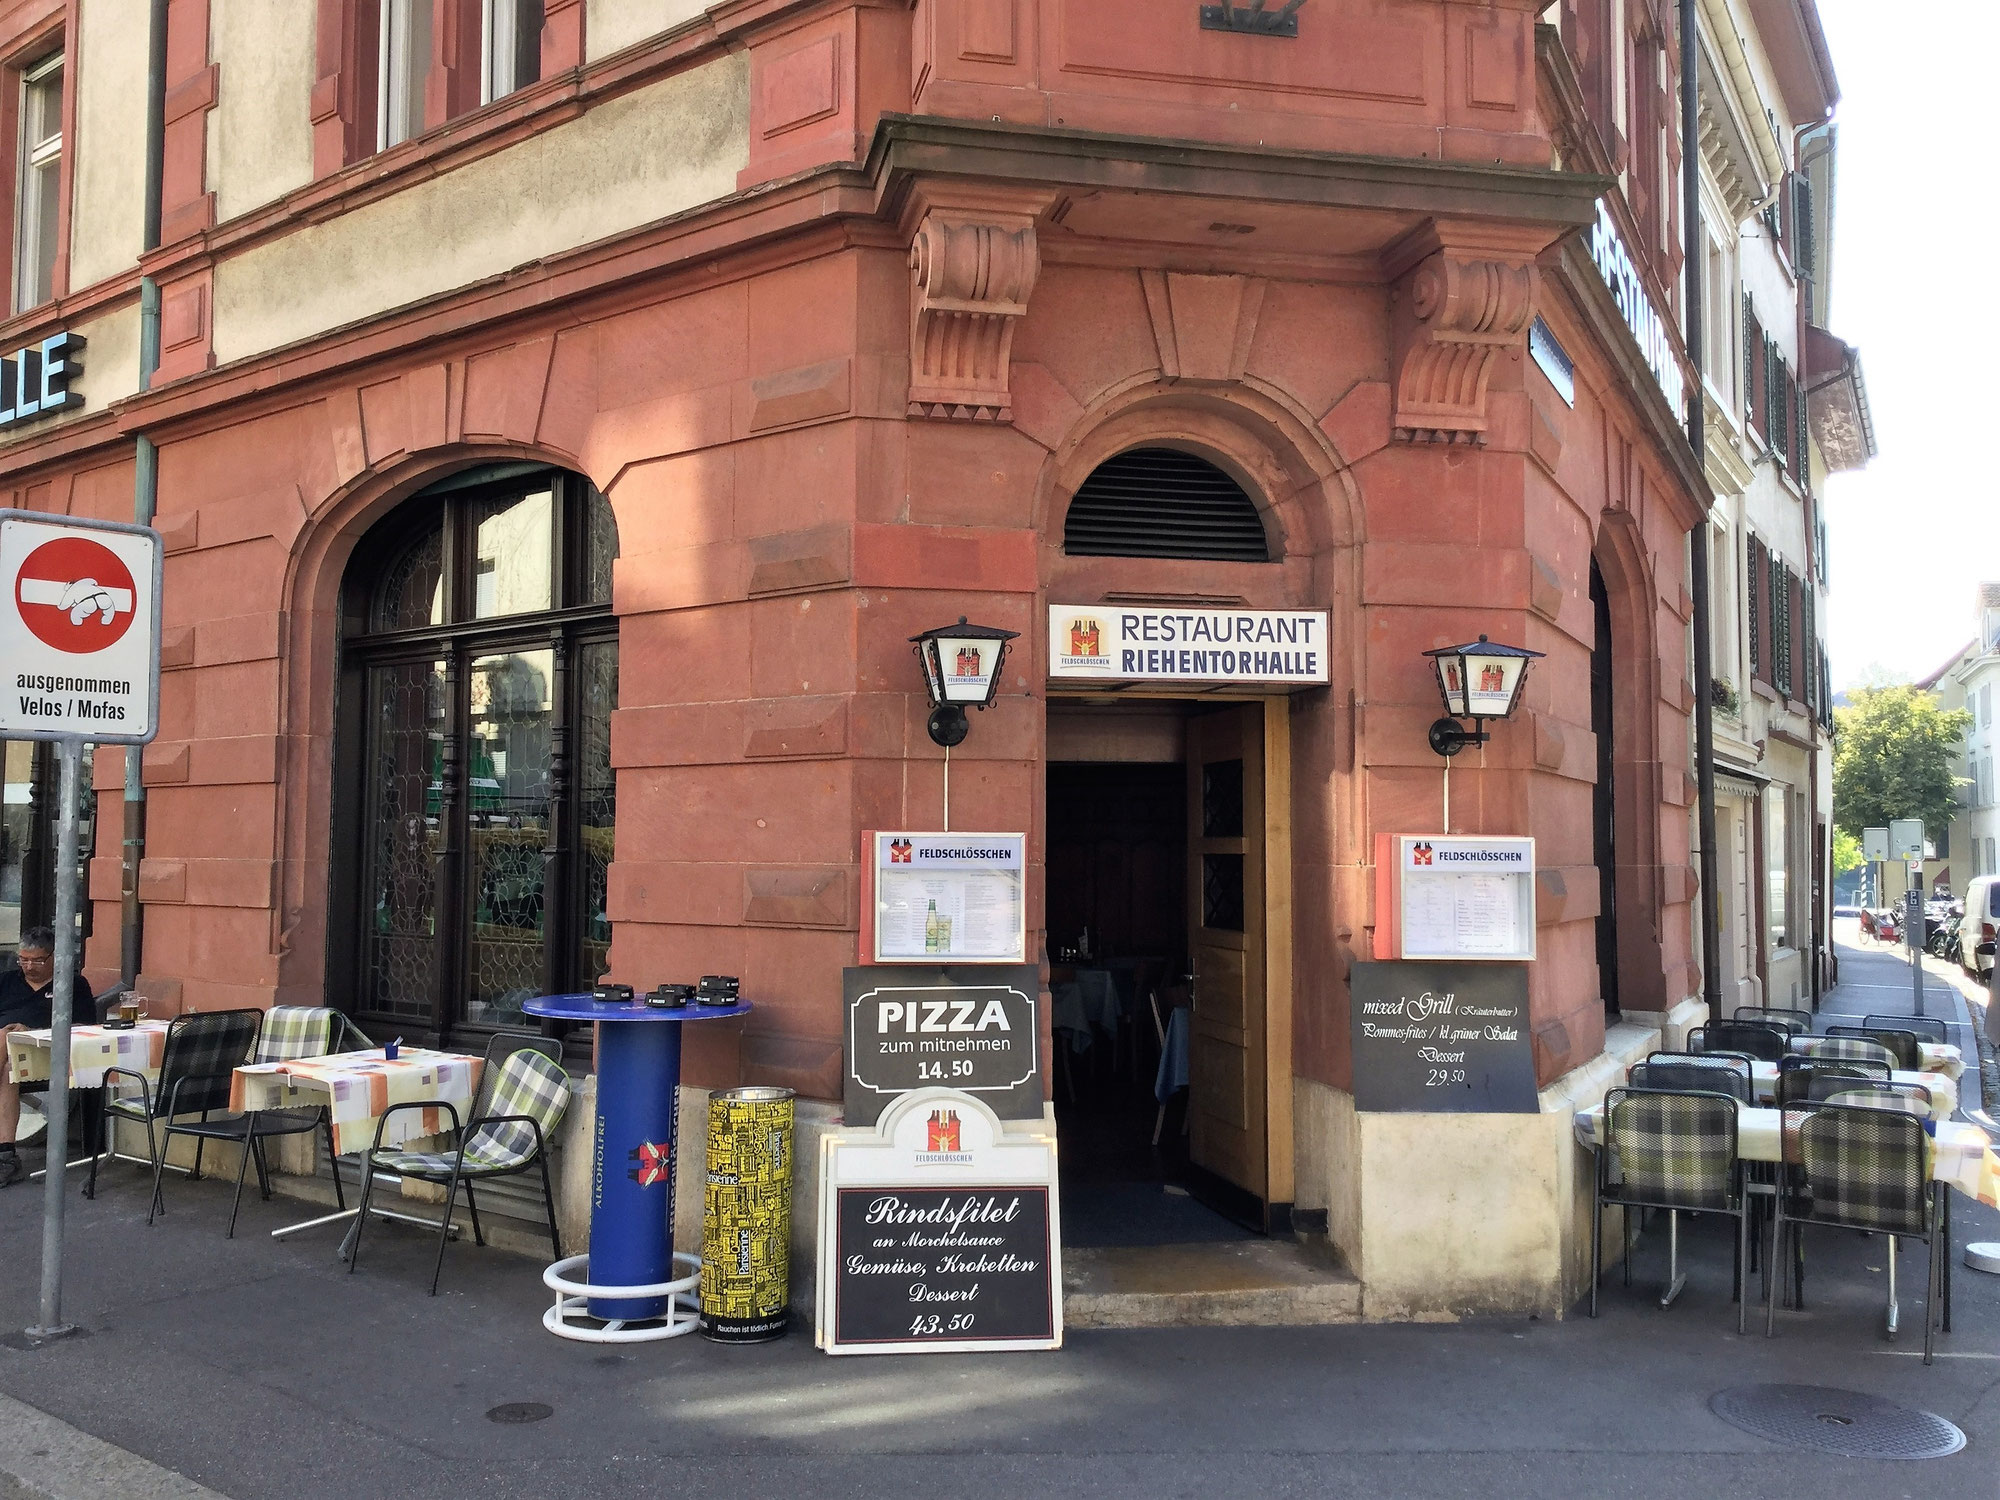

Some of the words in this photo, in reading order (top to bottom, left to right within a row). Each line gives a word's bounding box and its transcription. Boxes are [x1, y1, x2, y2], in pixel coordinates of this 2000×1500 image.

[1121, 614, 1316, 644] RESTAURANT
[1061, 657, 1110, 666] FELDSCHLÖSSCHEN
[1122, 649, 1317, 675] RIEHENTORHALLE
[17, 673, 130, 695] ausgenommen
[20, 696, 62, 717] Velos
[67, 699, 73, 717] /
[78, 699, 125, 720] Mofas
[919, 847, 1012, 859] FELDSCHLÖSSCHEN
[1439, 850, 1522, 862] FELDSCHLÖSSCHEN
[877, 1000, 1012, 1034] PIZZA
[1363, 997, 1405, 1015] mixed
[1406, 992, 1455, 1022] Grill
[1484, 1025, 1518, 1041] Salat
[879, 1041, 914, 1053] zum
[919, 1037, 1011, 1052] mitnehmen
[1417, 1046, 1465, 1063] Dessert
[918, 1060, 974, 1080] 14.50
[1426, 1069, 1466, 1086] 29.50
[595, 1115, 605, 1209] ALKOHOLFREI
[915, 1154, 973, 1163] FELDSCHLÖSSCHEN
[865, 1196, 1021, 1235] Rindsfilet
[872, 1237, 898, 1248] an
[901, 1232, 1006, 1248] Morchelsauce
[846, 1254, 928, 1278] Gemüse,
[935, 1253, 1040, 1274] Kroketten
[908, 1282, 980, 1303] Dessert
[908, 1313, 975, 1336] 43.50
